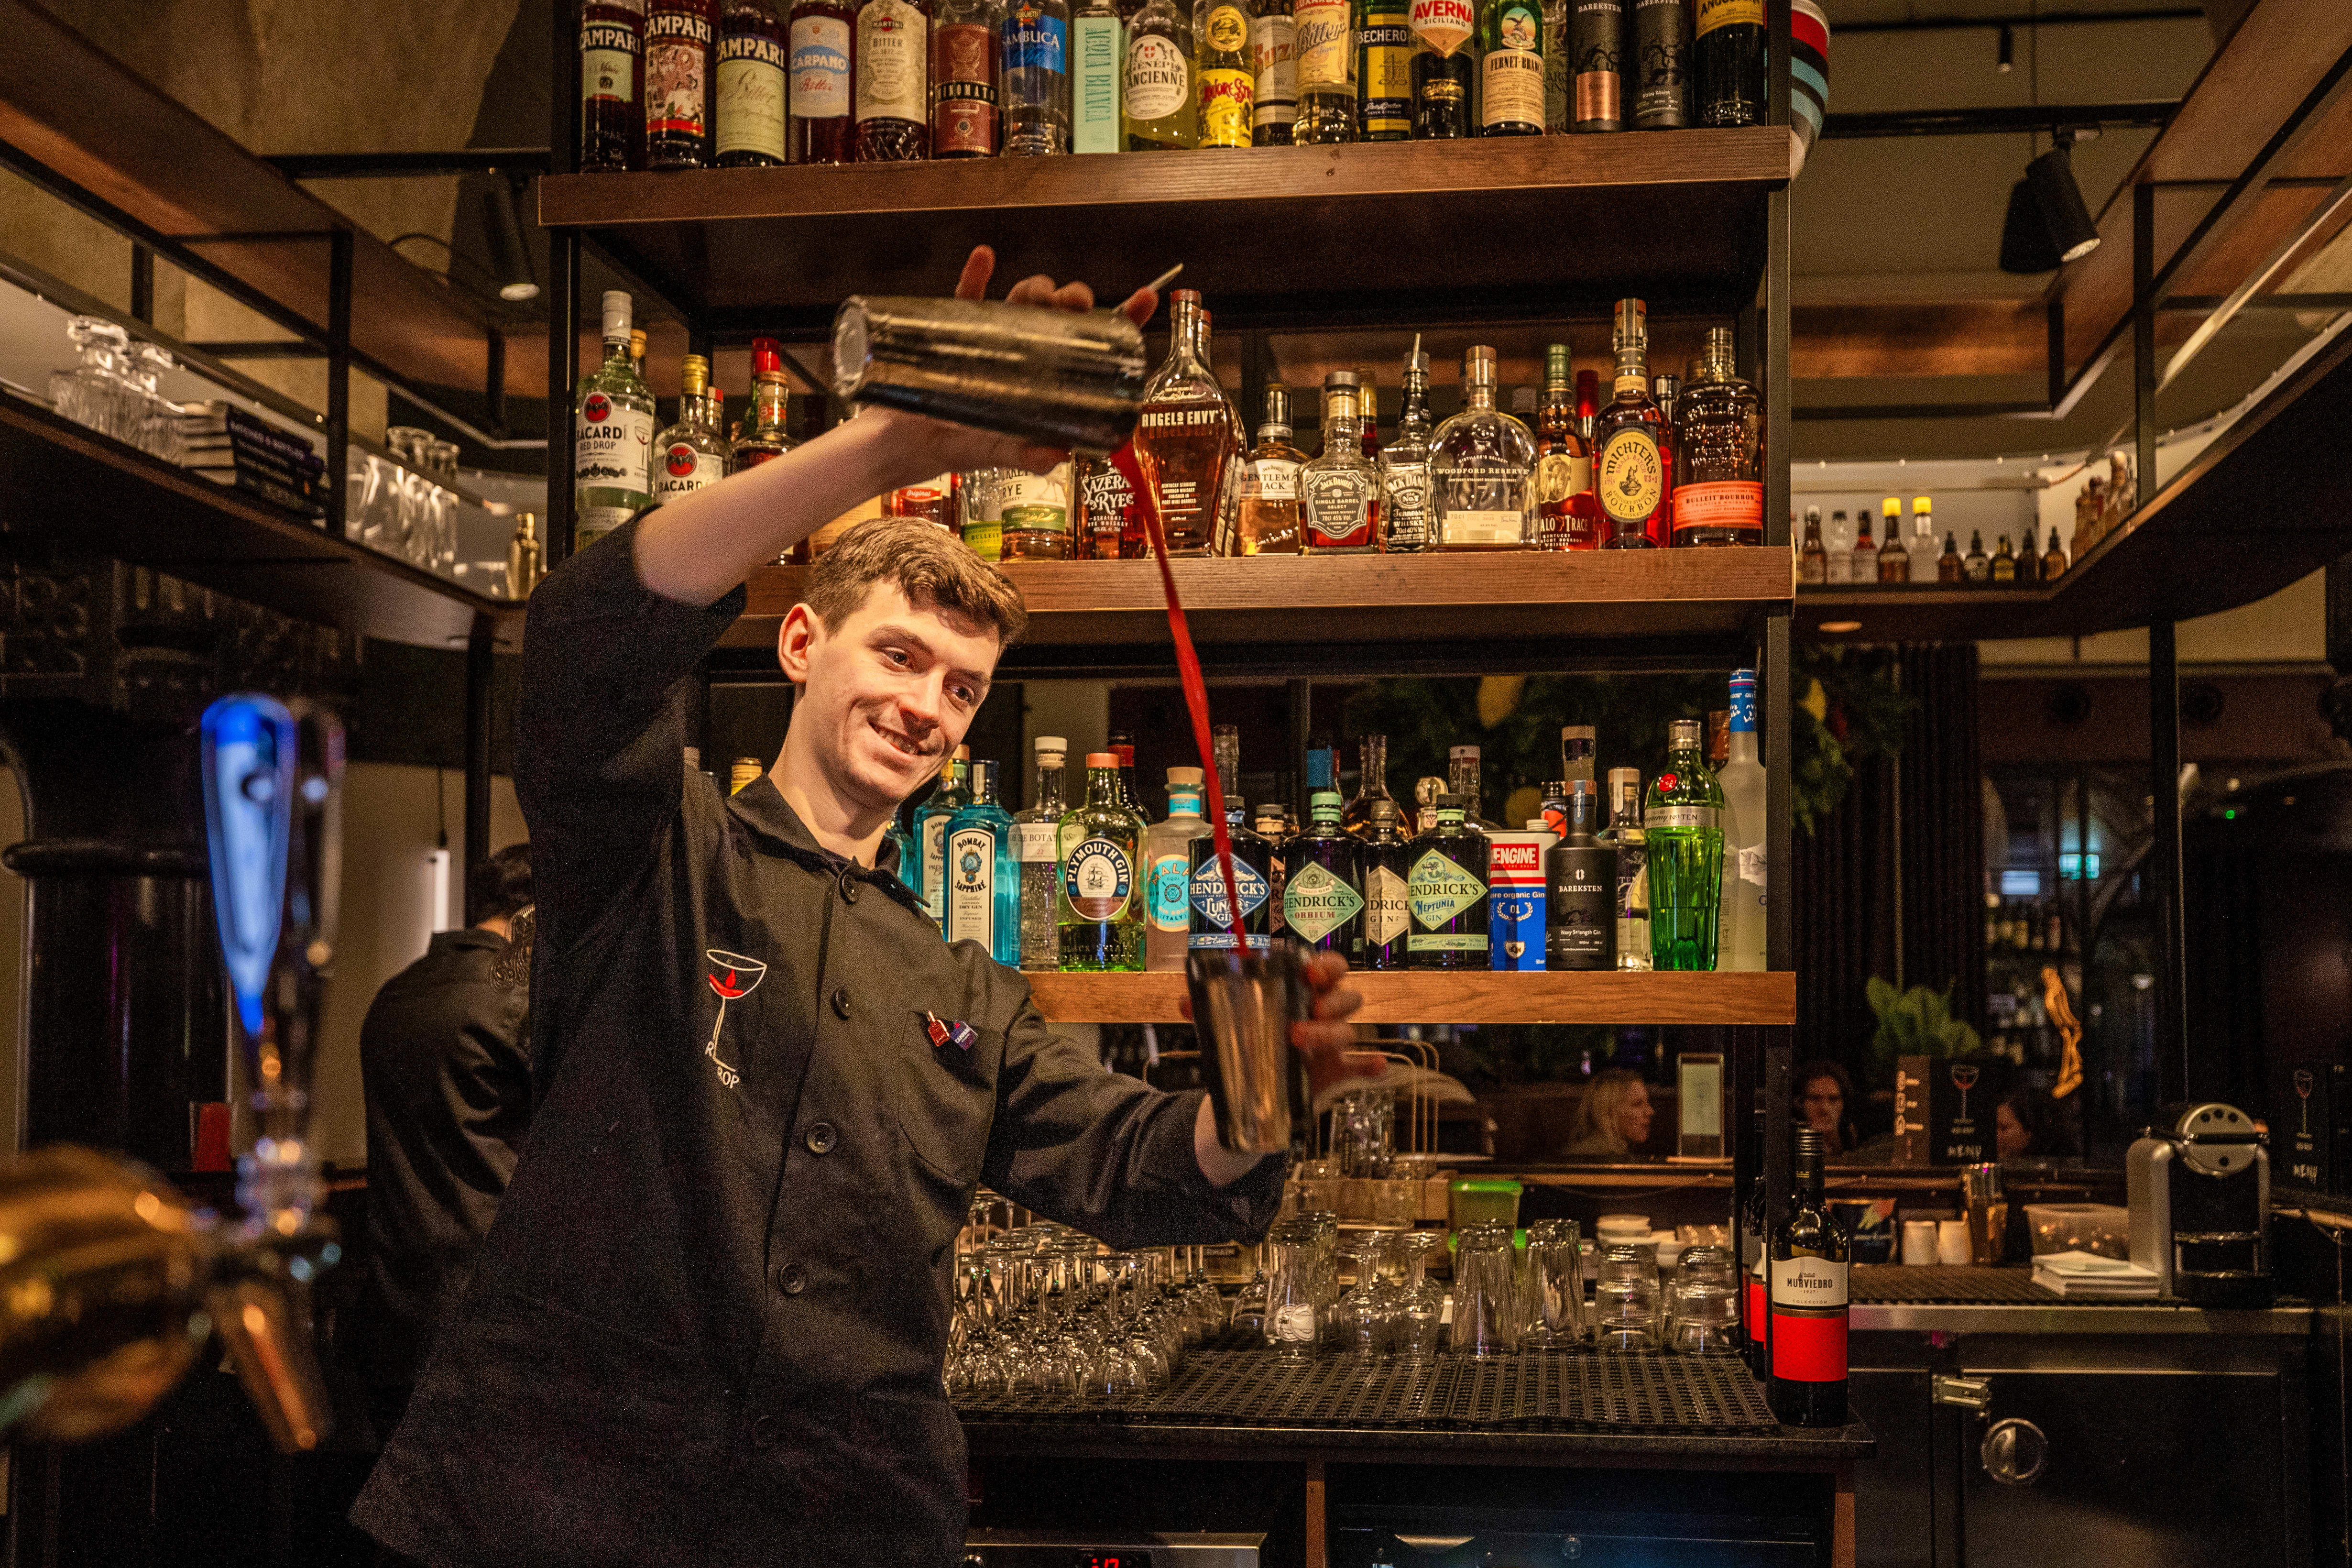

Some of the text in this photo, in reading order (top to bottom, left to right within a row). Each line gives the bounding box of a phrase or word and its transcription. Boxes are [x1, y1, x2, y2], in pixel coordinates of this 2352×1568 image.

[1578, 3, 1622, 13] BAREKSTEN
[1424, 17, 1466, 27] SICILIANO
[873, 37, 903, 48] BITTER
[792, 54, 847, 70] CARPANO
[1128, 70, 1185, 88] ANCIENNE
[1187, 409, 1215, 425] ENVY
[593, 440, 616, 450] DROP
[1606, 441, 1657, 475] MICHTER'S
[1616, 455, 1647, 474] SMALL BATCH
[1405, 473, 1424, 488] DAN
[906, 490, 932, 498] Original
[1082, 472, 1133, 505] SAZERA
[1606, 488, 1657, 513] BOURBON
[1686, 495, 1716, 504] BULLEIT
[1541, 515, 1588, 533] ALO TRACE
[957, 837, 986, 851] BOMBAY
[1029, 833, 1059, 842] BOTAN
[1494, 847, 1536, 864] ENGINE
[1067, 843, 1119, 882] PLYMOUTH
[1115, 859, 1129, 884] GIN
[954, 880, 987, 893] SAPPHIRE
[1503, 891, 1530, 899] organic
[1284, 896, 1356, 909] HENDRICK'S
[1415, 899, 1455, 916] NEPTUNIA
[1787, 1278, 1833, 1289] MURVIEDRO
